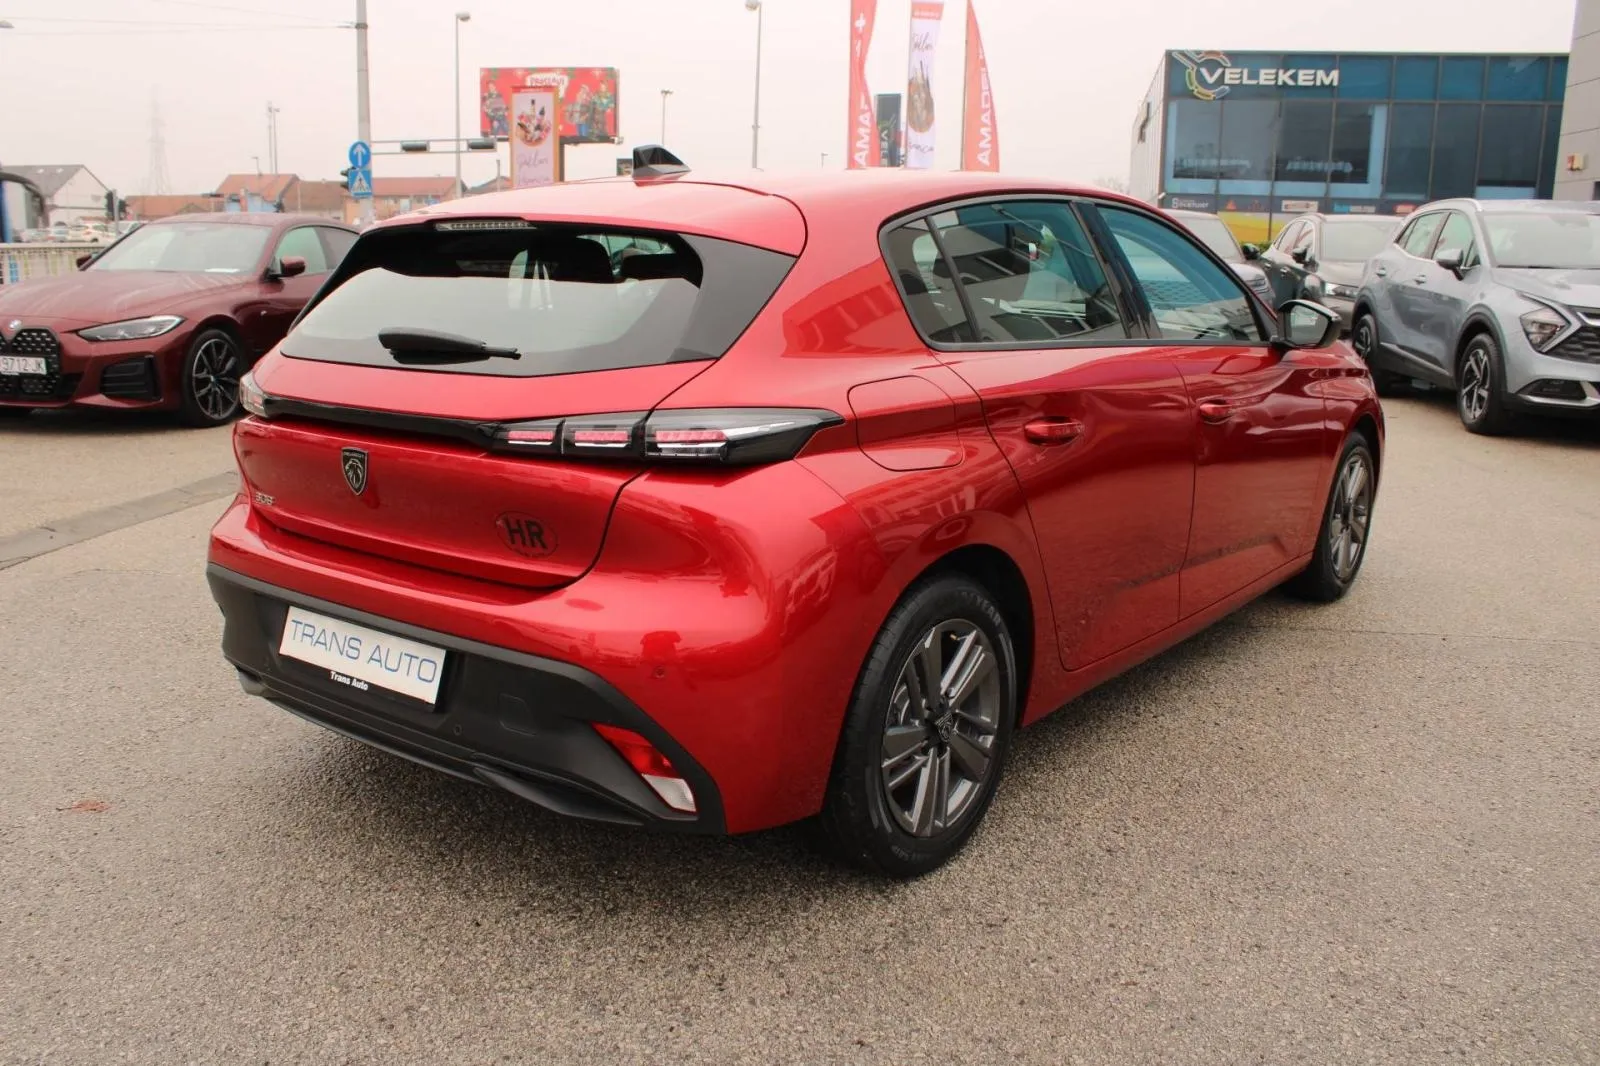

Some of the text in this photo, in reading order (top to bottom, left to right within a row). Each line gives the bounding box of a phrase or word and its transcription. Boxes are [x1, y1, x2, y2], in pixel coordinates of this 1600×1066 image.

[1200, 67, 1339, 87] VELEKEM
[502, 515, 548, 550] HR
[291, 619, 438, 684] TRANS AUTO
[330, 671, 369, 692] Trans Auto
